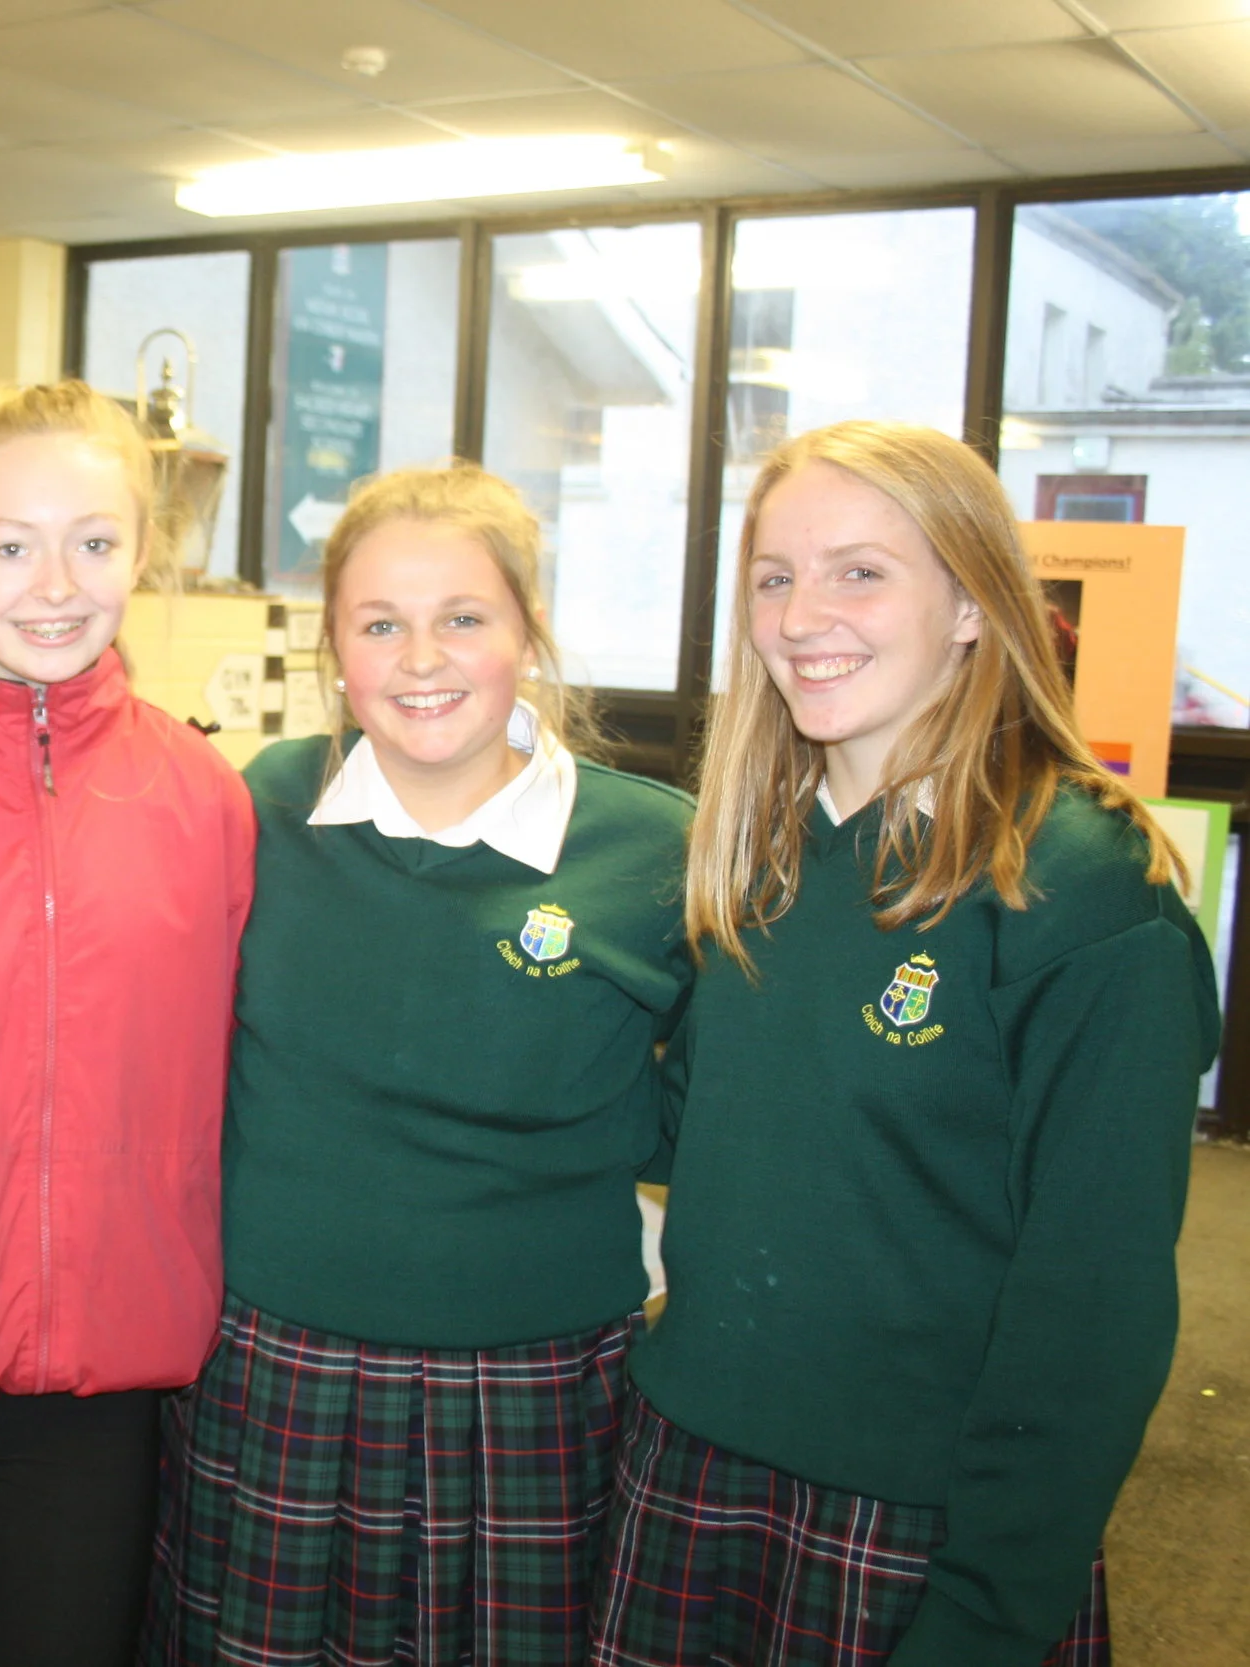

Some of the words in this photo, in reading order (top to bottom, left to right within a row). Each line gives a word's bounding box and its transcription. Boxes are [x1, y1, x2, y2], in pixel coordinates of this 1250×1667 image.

[1041, 554, 1131, 571] Champions!
[496, 940, 523, 970] Cloich
[525, 965, 541, 977] na
[861, 1004, 884, 1035] Cloich
[886, 1031, 901, 1045] na
